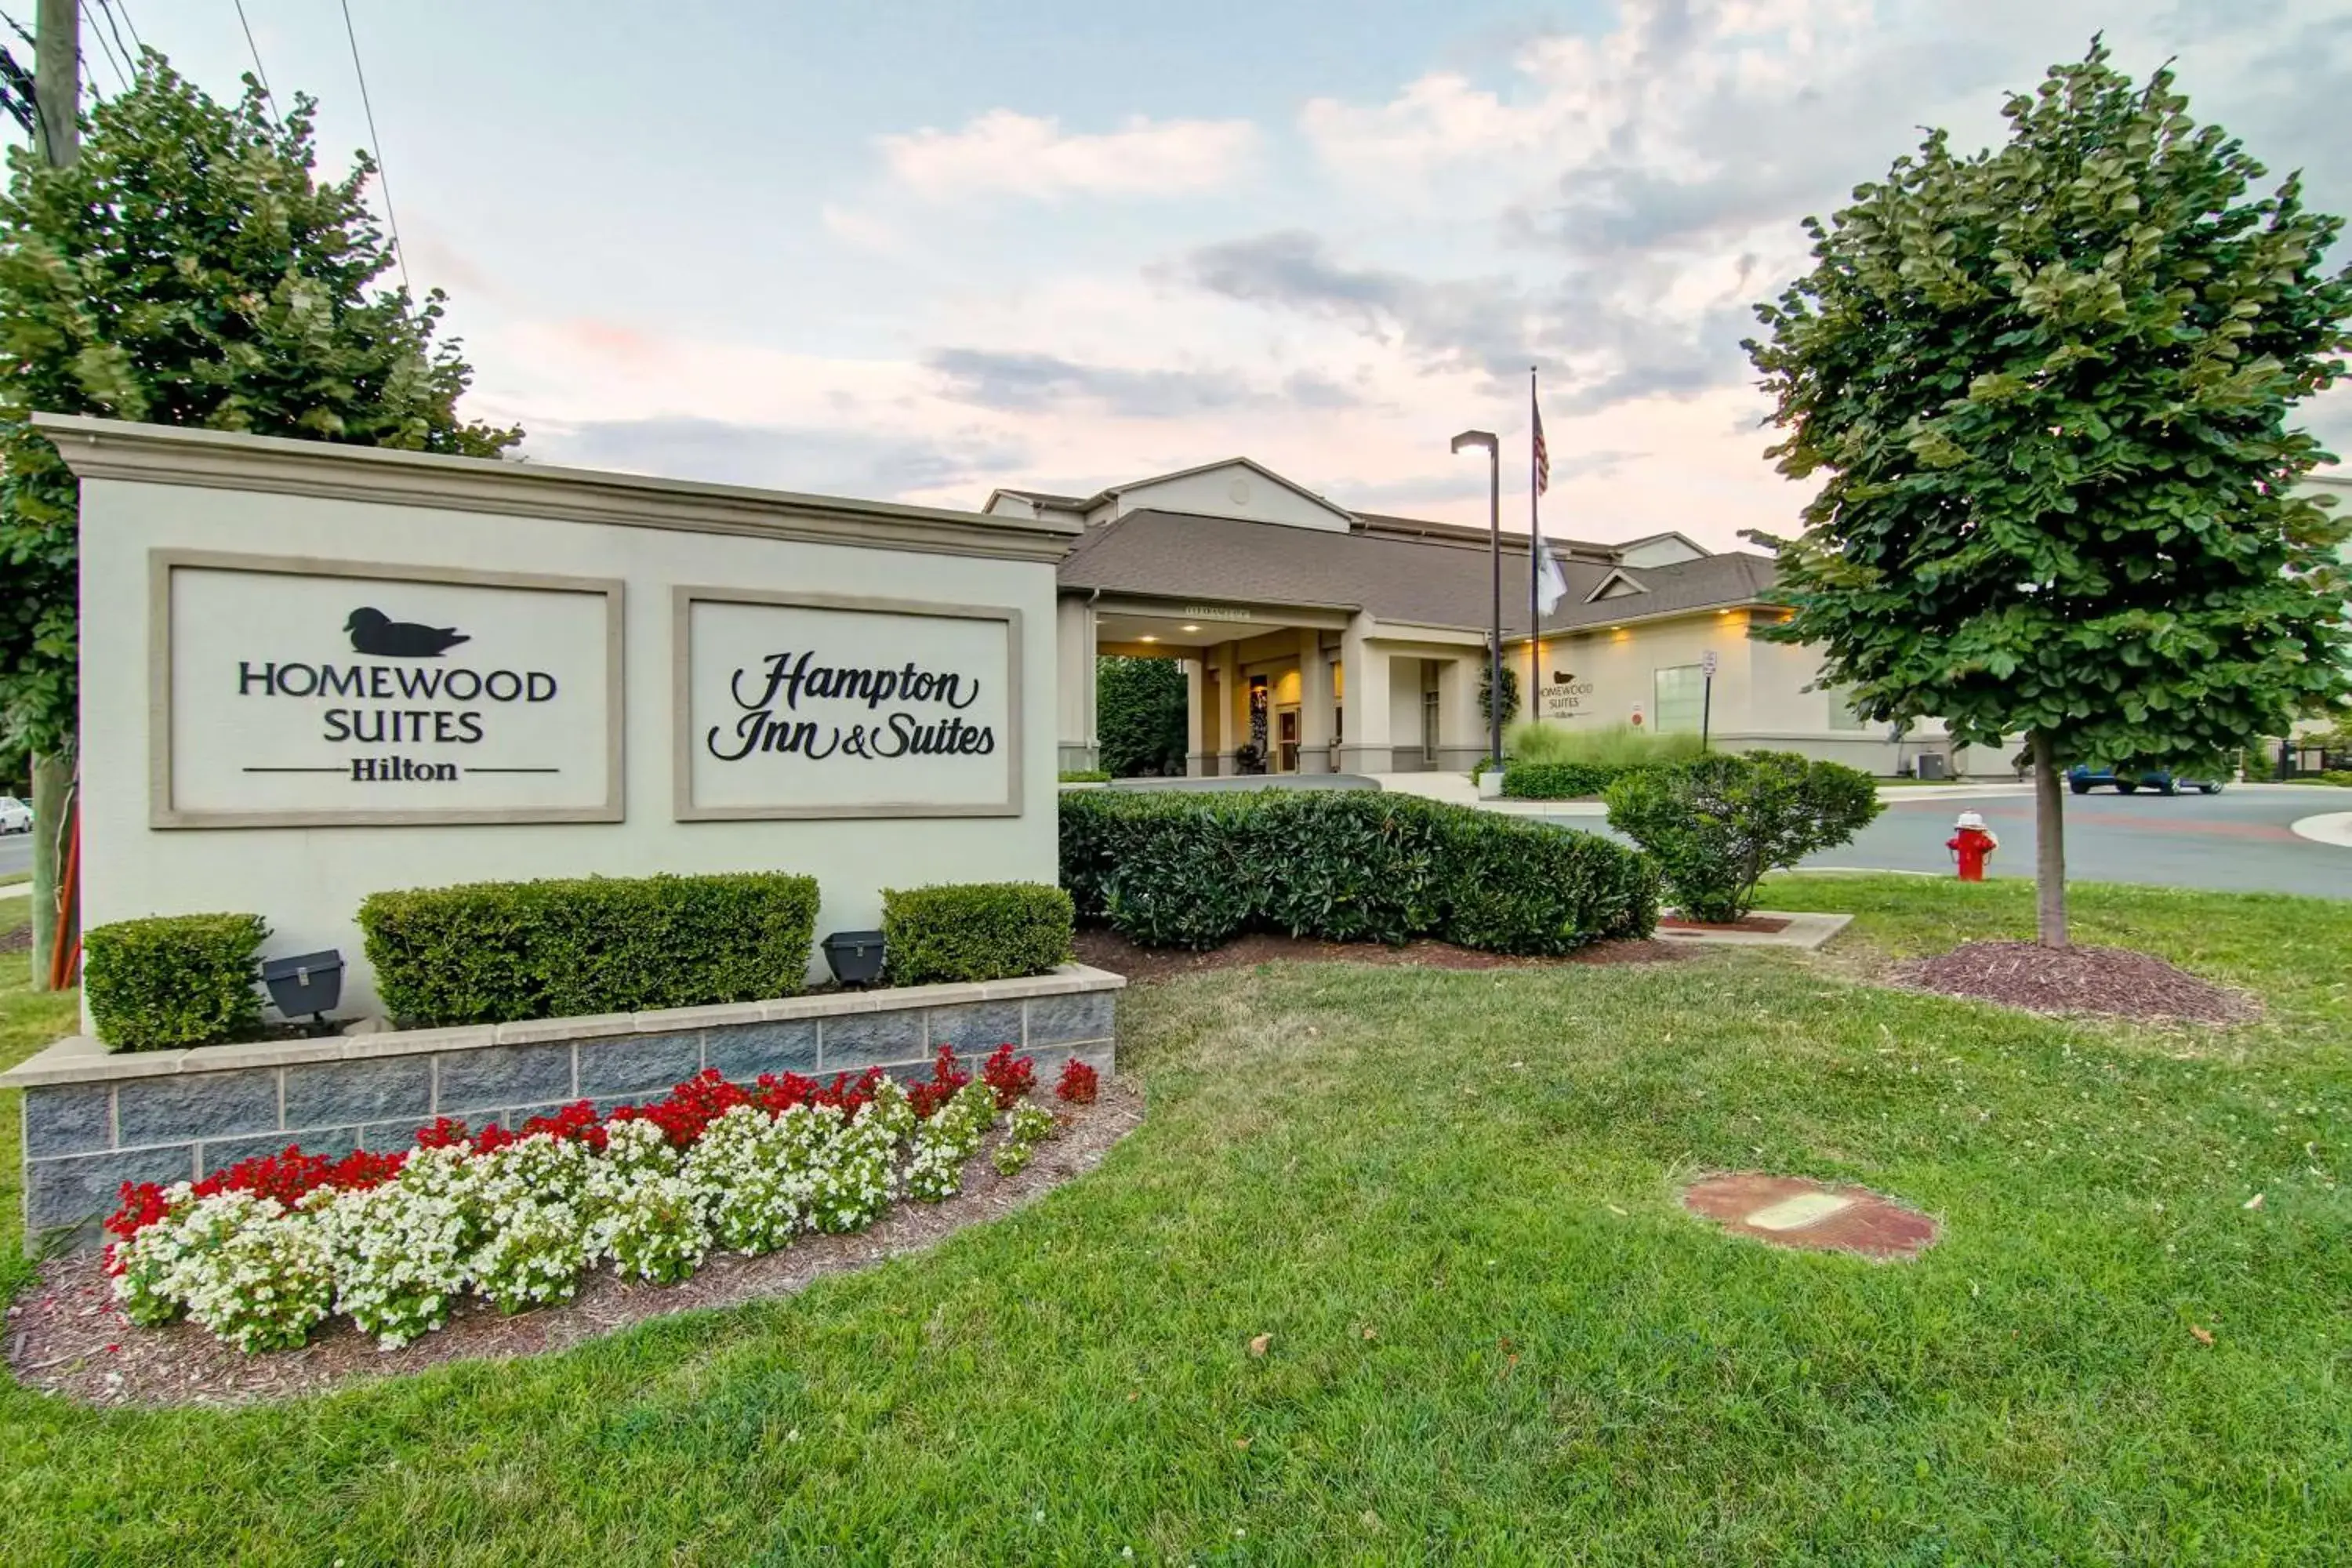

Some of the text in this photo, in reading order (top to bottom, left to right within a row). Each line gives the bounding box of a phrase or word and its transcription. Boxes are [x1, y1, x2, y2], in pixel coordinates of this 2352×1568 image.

[238, 661, 557, 702] HOMEWOOD
[731, 651, 979, 710] Hampton
[1539, 684, 1593, 697] OMEWOOD
[1549, 697, 1580, 709] SUITES
[324, 708, 484, 743] SUITES
[707, 710, 995, 761] Inn & Suites
[350, 755, 458, 782] Hilton
